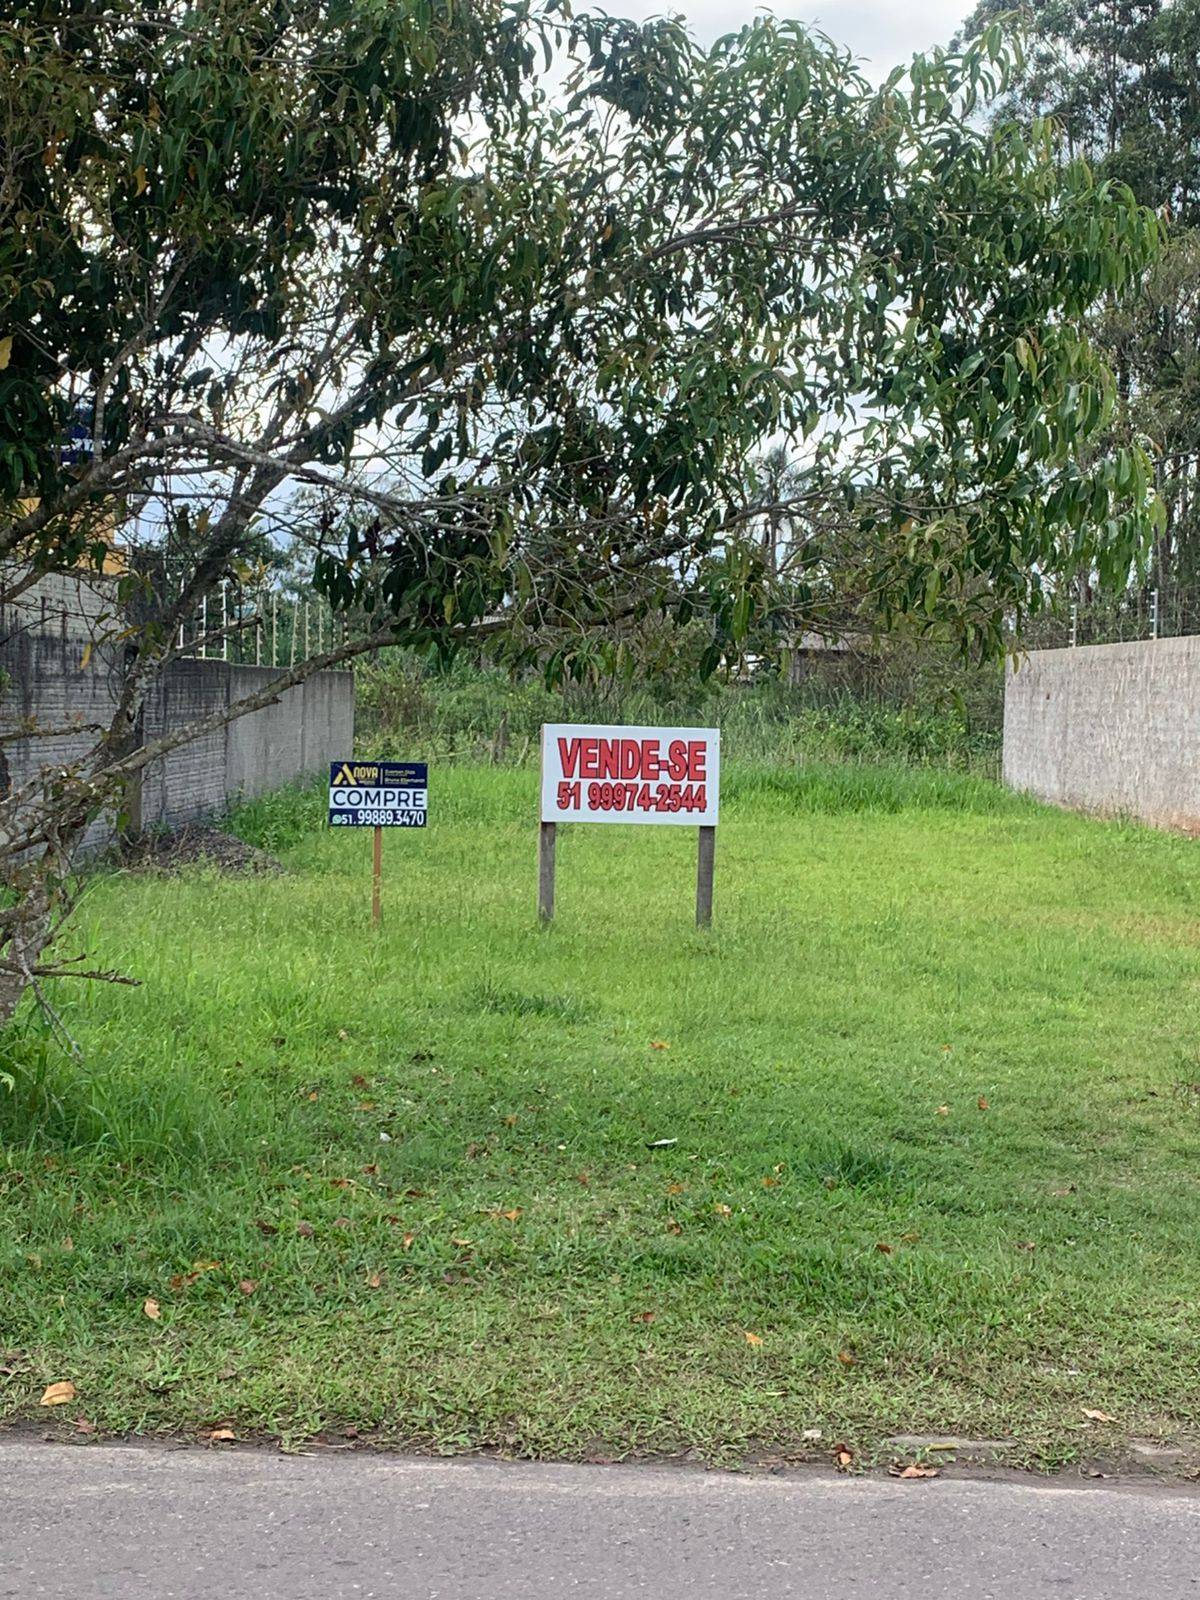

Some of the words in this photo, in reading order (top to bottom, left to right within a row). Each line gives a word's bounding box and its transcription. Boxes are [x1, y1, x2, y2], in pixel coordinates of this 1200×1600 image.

[557, 738, 707, 781] VENDE-SE
[332, 789, 424, 807] COMPRE
[556, 782, 581, 810] 51
[588, 782, 707, 813] 99974-2544
